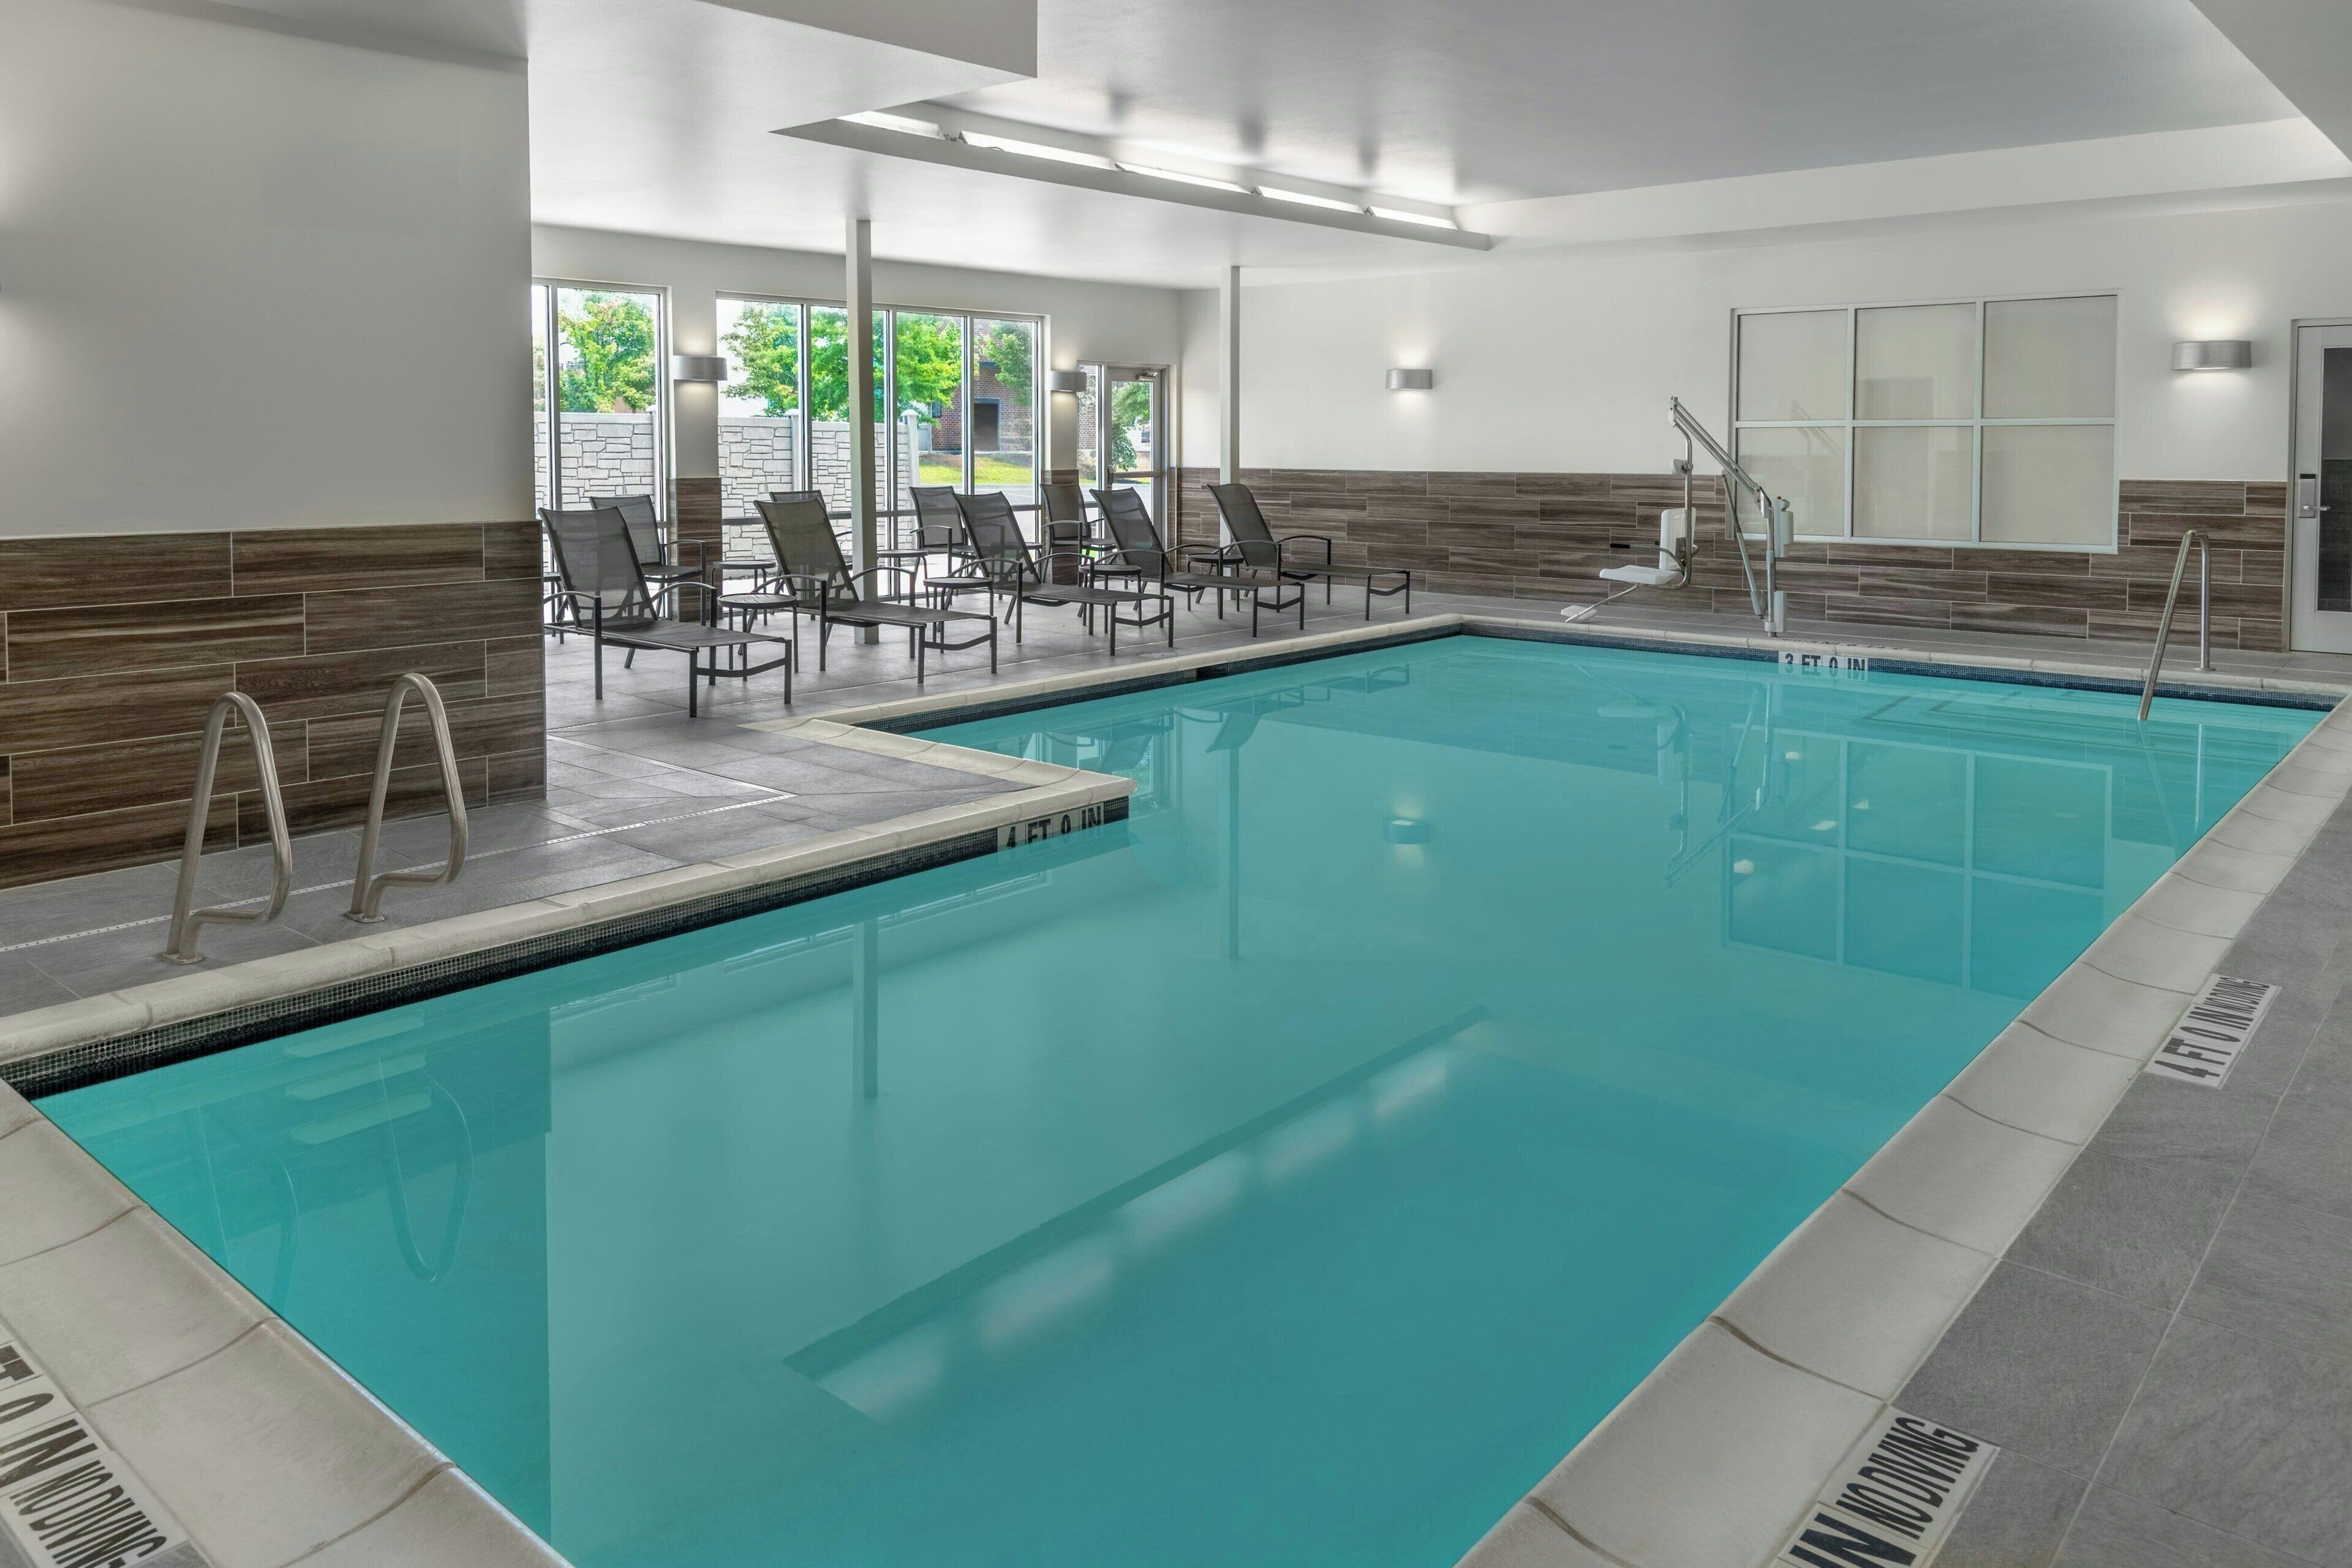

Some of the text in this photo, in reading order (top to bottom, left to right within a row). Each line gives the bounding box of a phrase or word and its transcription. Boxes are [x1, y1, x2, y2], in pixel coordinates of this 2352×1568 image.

[1785, 653, 1793, 664] 3
[1802, 654, 1821, 666] FT
[1847, 658, 1865, 671] IN
[1006, 826, 1017, 848] 4
[1028, 818, 1051, 843] FT
[1082, 805, 1101, 830] IN
[2209, 976, 2270, 1005] DIVING
[2187, 1006, 2254, 1030] IN
[2203, 997, 2257, 1015] NO
[2162, 1037, 2232, 1066] FT
[2154, 1060, 2220, 1079] 4
[0, 1419, 98, 1488] IN
[1857, 1417, 1980, 1508] DIVING
[9, 1460, 113, 1516] NO
[1836, 1483, 1933, 1540] NO
